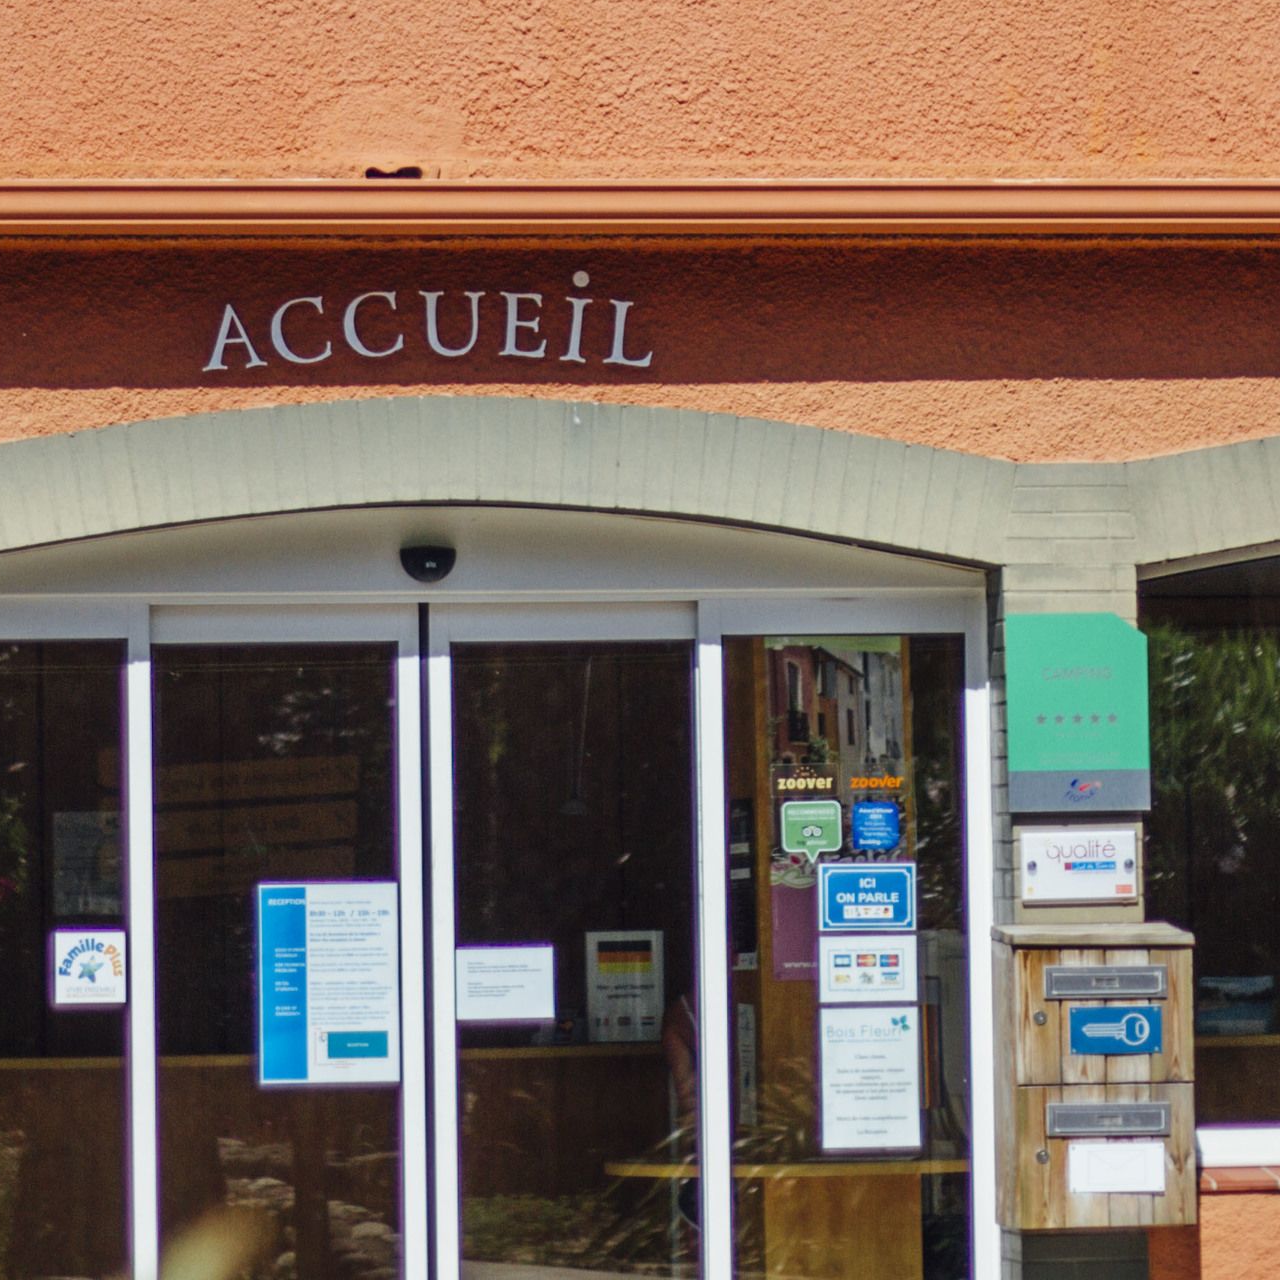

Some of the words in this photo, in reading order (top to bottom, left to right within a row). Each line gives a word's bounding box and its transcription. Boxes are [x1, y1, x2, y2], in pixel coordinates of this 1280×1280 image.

[1041, 666, 1114, 681] CAMPING
[777, 776, 833, 790] zoover
[850, 774, 904, 789] zoover
[1046, 839, 1116, 863] qualité
[859, 878, 876, 888] ICI
[836, 893, 855, 903] ON
[858, 892, 900, 903] PARLE
[58, 937, 105, 976] Famille
[104, 944, 123, 977] Plus
[826, 1025, 855, 1039] Bois
[861, 1024, 903, 1038] Fleuri
